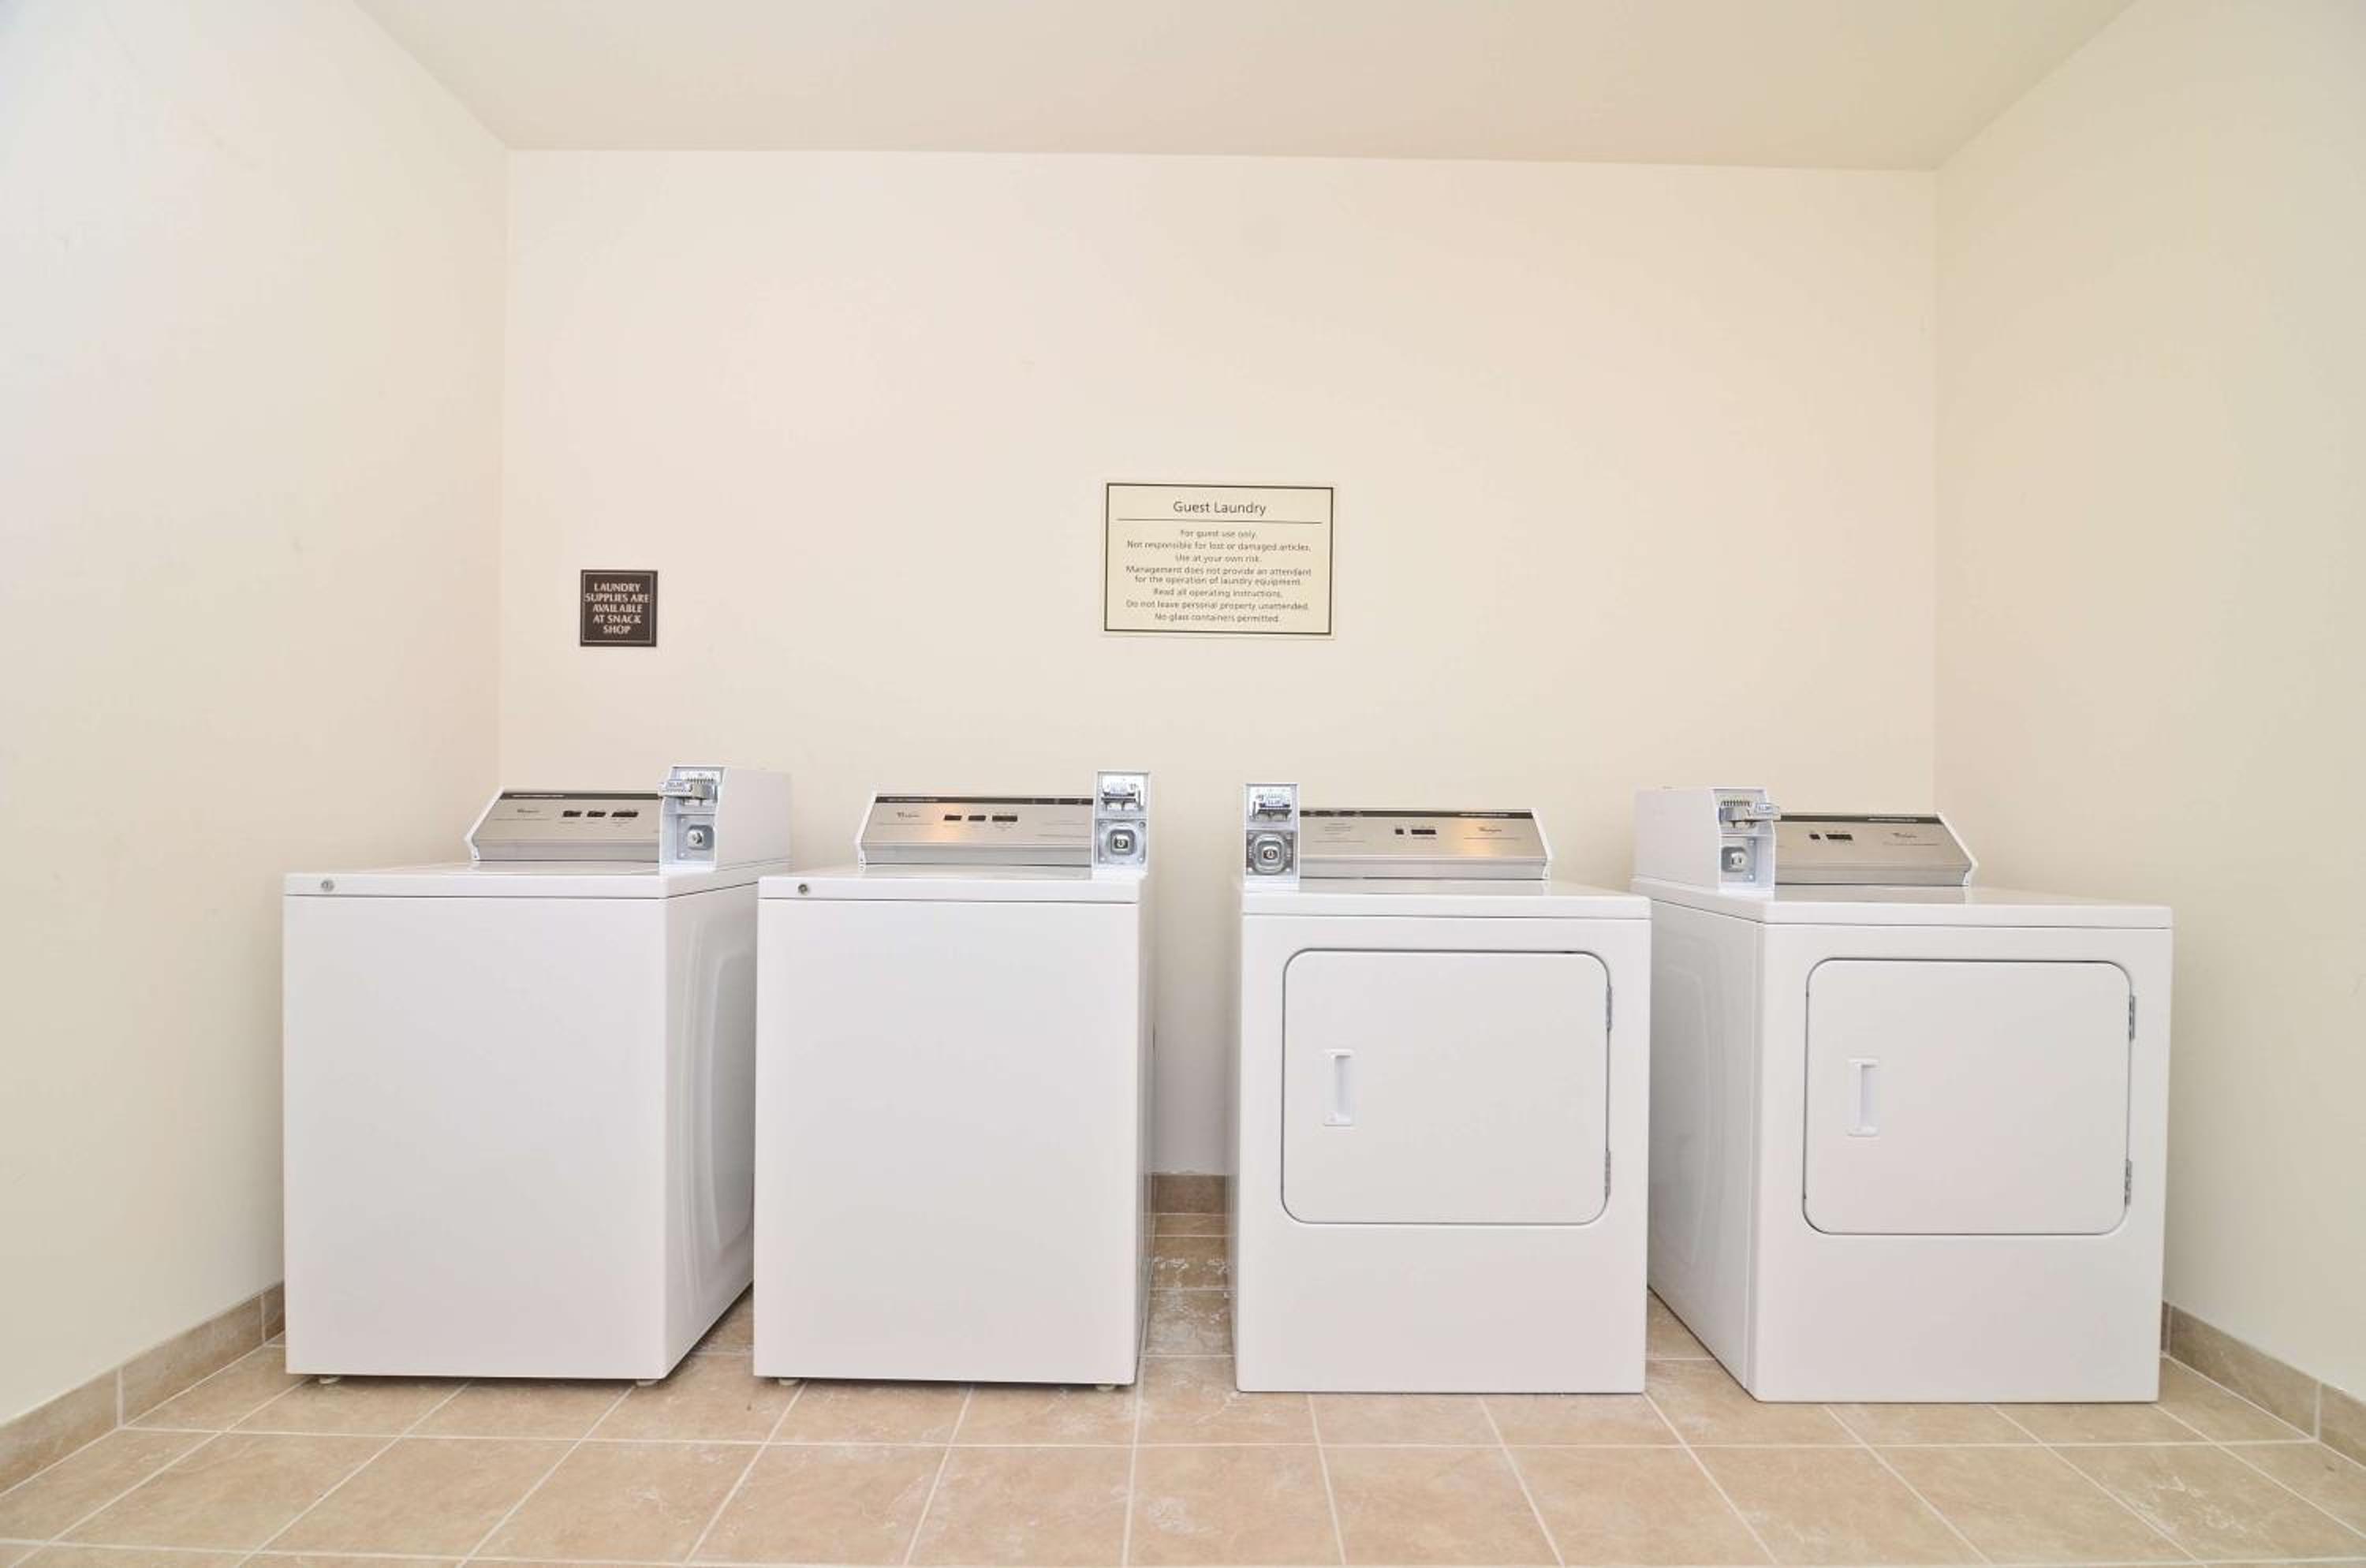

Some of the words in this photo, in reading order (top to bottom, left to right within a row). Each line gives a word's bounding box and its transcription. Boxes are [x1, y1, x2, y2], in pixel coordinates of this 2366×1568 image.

[1173, 501, 1211, 513] Guest
[1215, 501, 1267, 517] Laundry
[1181, 528, 1194, 537] For
[1196, 529, 1218, 539] guest
[1127, 539, 1143, 549] Not
[1144, 540, 1192, 551] responsible
[1194, 541, 1206, 550] for
[1237, 542, 1277, 552] damaged
[1175, 554, 1190, 562] Use
[1203, 555, 1222, 564] your
[1125, 565, 1182, 575] Management
[1184, 566, 1204, 574] does
[1222, 567, 1255, 576] provide
[1270, 567, 1312, 576] attendant
[594, 582, 641, 592] LAUNDRY
[1166, 576, 1207, 585] operation
[1220, 577, 1252, 587] laundry
[585, 592, 628, 603] SUPPLIES
[630, 594, 650, 603] ARE
[1154, 587, 1174, 595] Read
[1189, 588, 1231, 599] operating
[592, 603, 643, 613] AVAILABLE
[1125, 599, 1139, 607] Do
[1157, 599, 1179, 608] leave
[1181, 601, 1218, 610] personal
[1220, 602, 1256, 612] property
[592, 614, 605, 624] AT
[607, 614, 641, 624] SNACK
[1169, 612, 1189, 622] glass
[603, 625, 631, 634] SHOP
